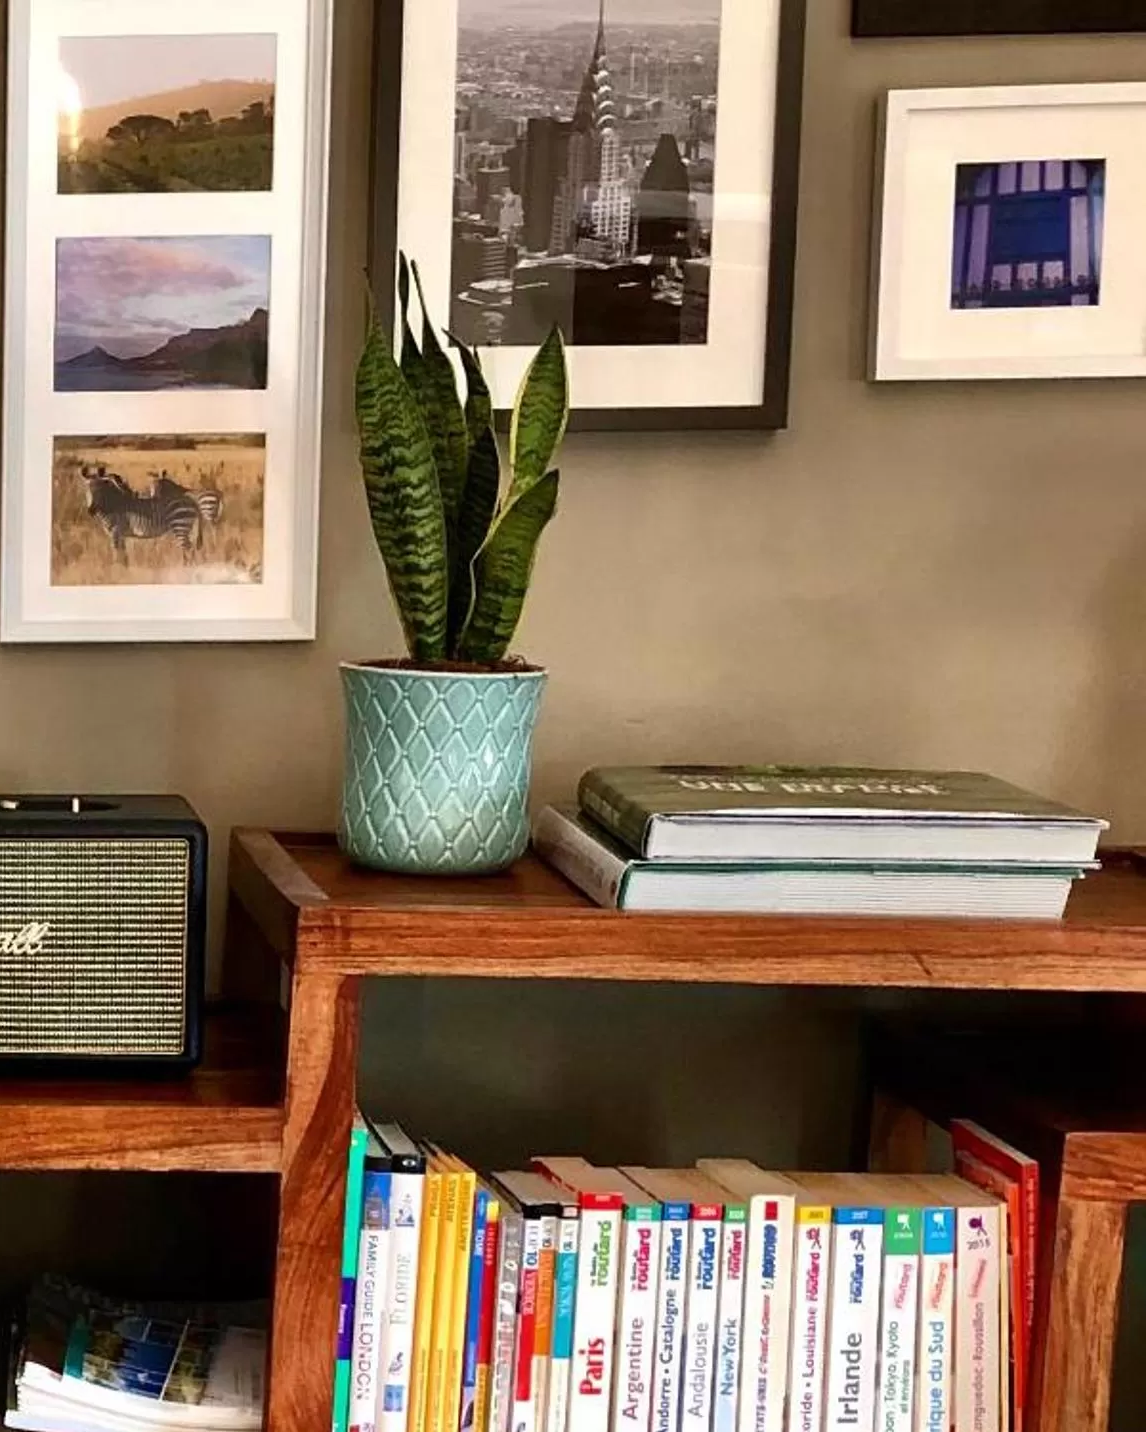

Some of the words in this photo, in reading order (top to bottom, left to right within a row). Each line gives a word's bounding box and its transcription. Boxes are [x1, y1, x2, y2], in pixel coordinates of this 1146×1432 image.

[365, 1234, 379, 1279] FAMILY
[525, 1250, 538, 1266] 10
[596, 1220, 613, 1287] routard
[636, 1228, 652, 1291] routard
[668, 1227, 683, 1281] routard
[700, 1227, 716, 1290] routard
[727, 1229, 743, 1281] routard
[362, 1281, 376, 1319] GUIDE
[523, 1271, 536, 1317] VENICE
[659, 1288, 680, 1365] Catalogne
[721, 1318, 738, 1357] York
[802, 1307, 819, 1378] Louisiane
[887, 1320, 901, 1358] Kyoto
[927, 1321, 945, 1354] Sud
[356, 1322, 375, 1400] LONDON
[578, 1337, 605, 1396] Paris
[622, 1316, 645, 1421] Argentine
[686, 1321, 709, 1418] Andalousie
[720, 1357, 735, 1396] New
[837, 1332, 864, 1425] Irlande
[928, 1360, 944, 1382] du
